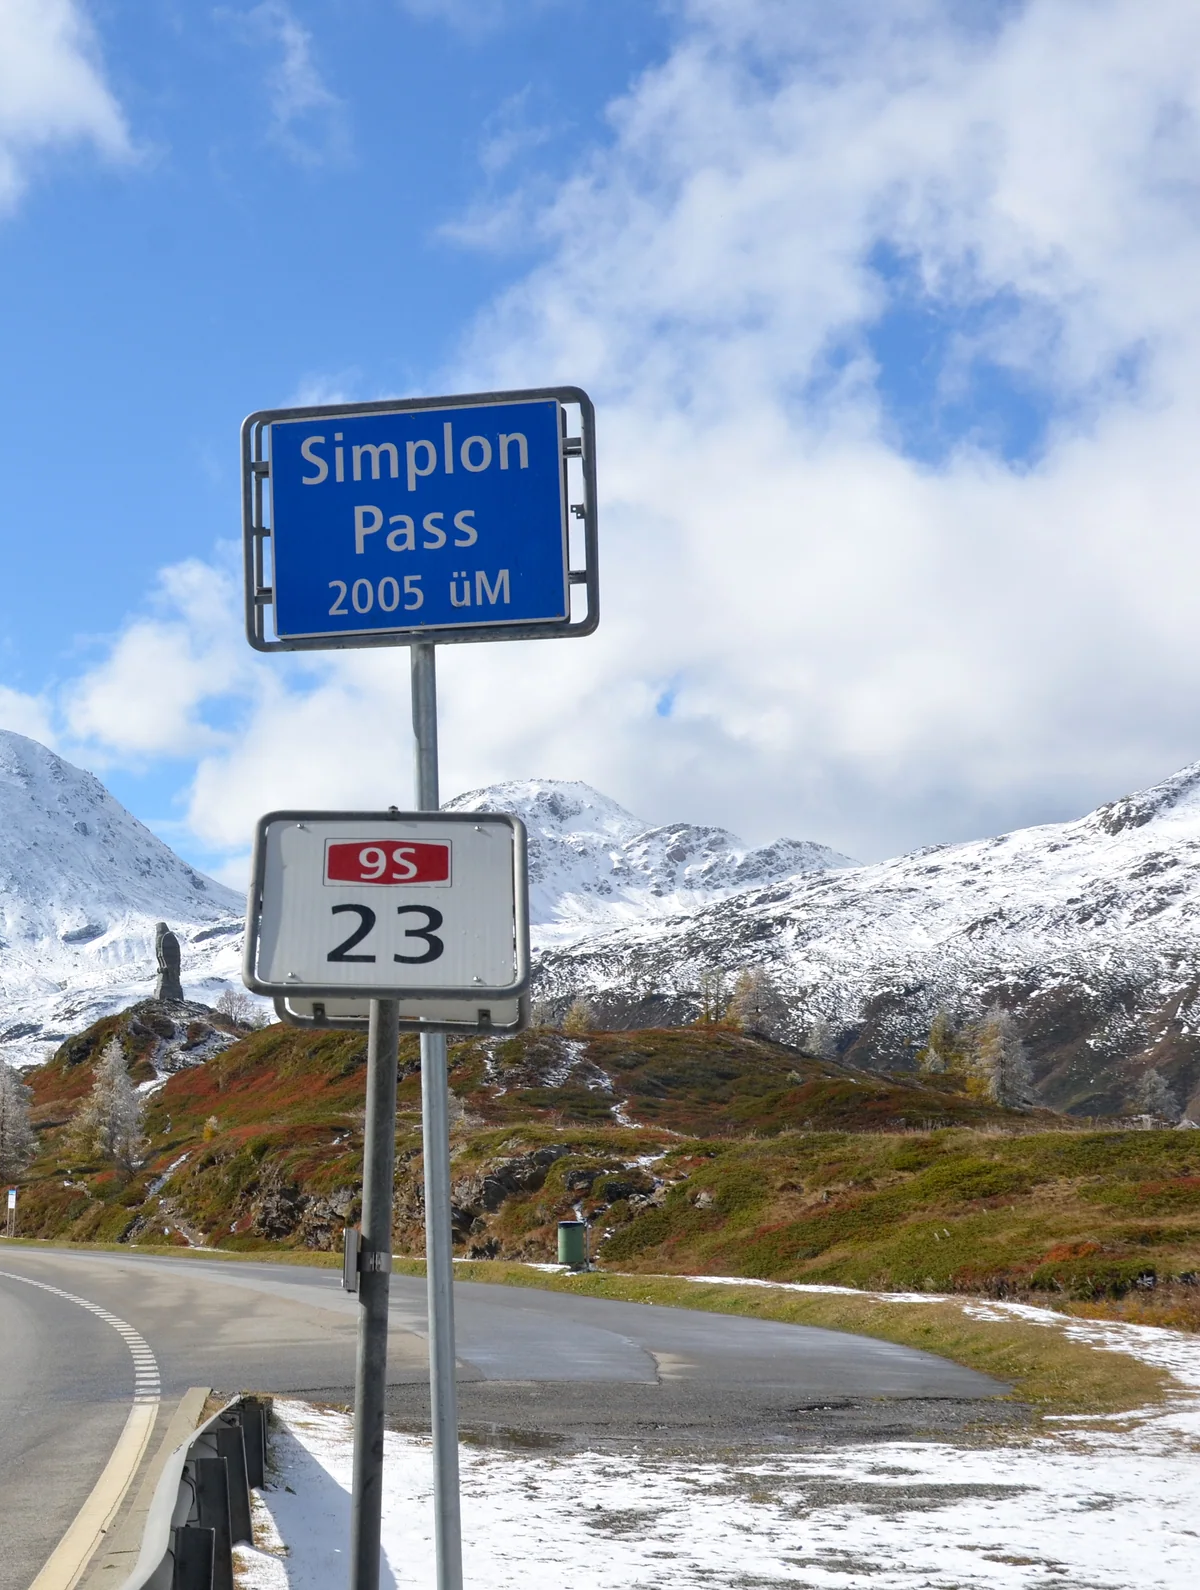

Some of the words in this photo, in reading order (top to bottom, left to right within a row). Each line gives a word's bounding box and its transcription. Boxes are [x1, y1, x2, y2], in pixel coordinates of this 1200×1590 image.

[300, 422, 529, 492] Simplon
[354, 505, 478, 555] Pass
[328, 574, 424, 616] 2005
[450, 569, 511, 607] üM
[358, 847, 418, 880] 9S
[326, 903, 444, 964] 23
